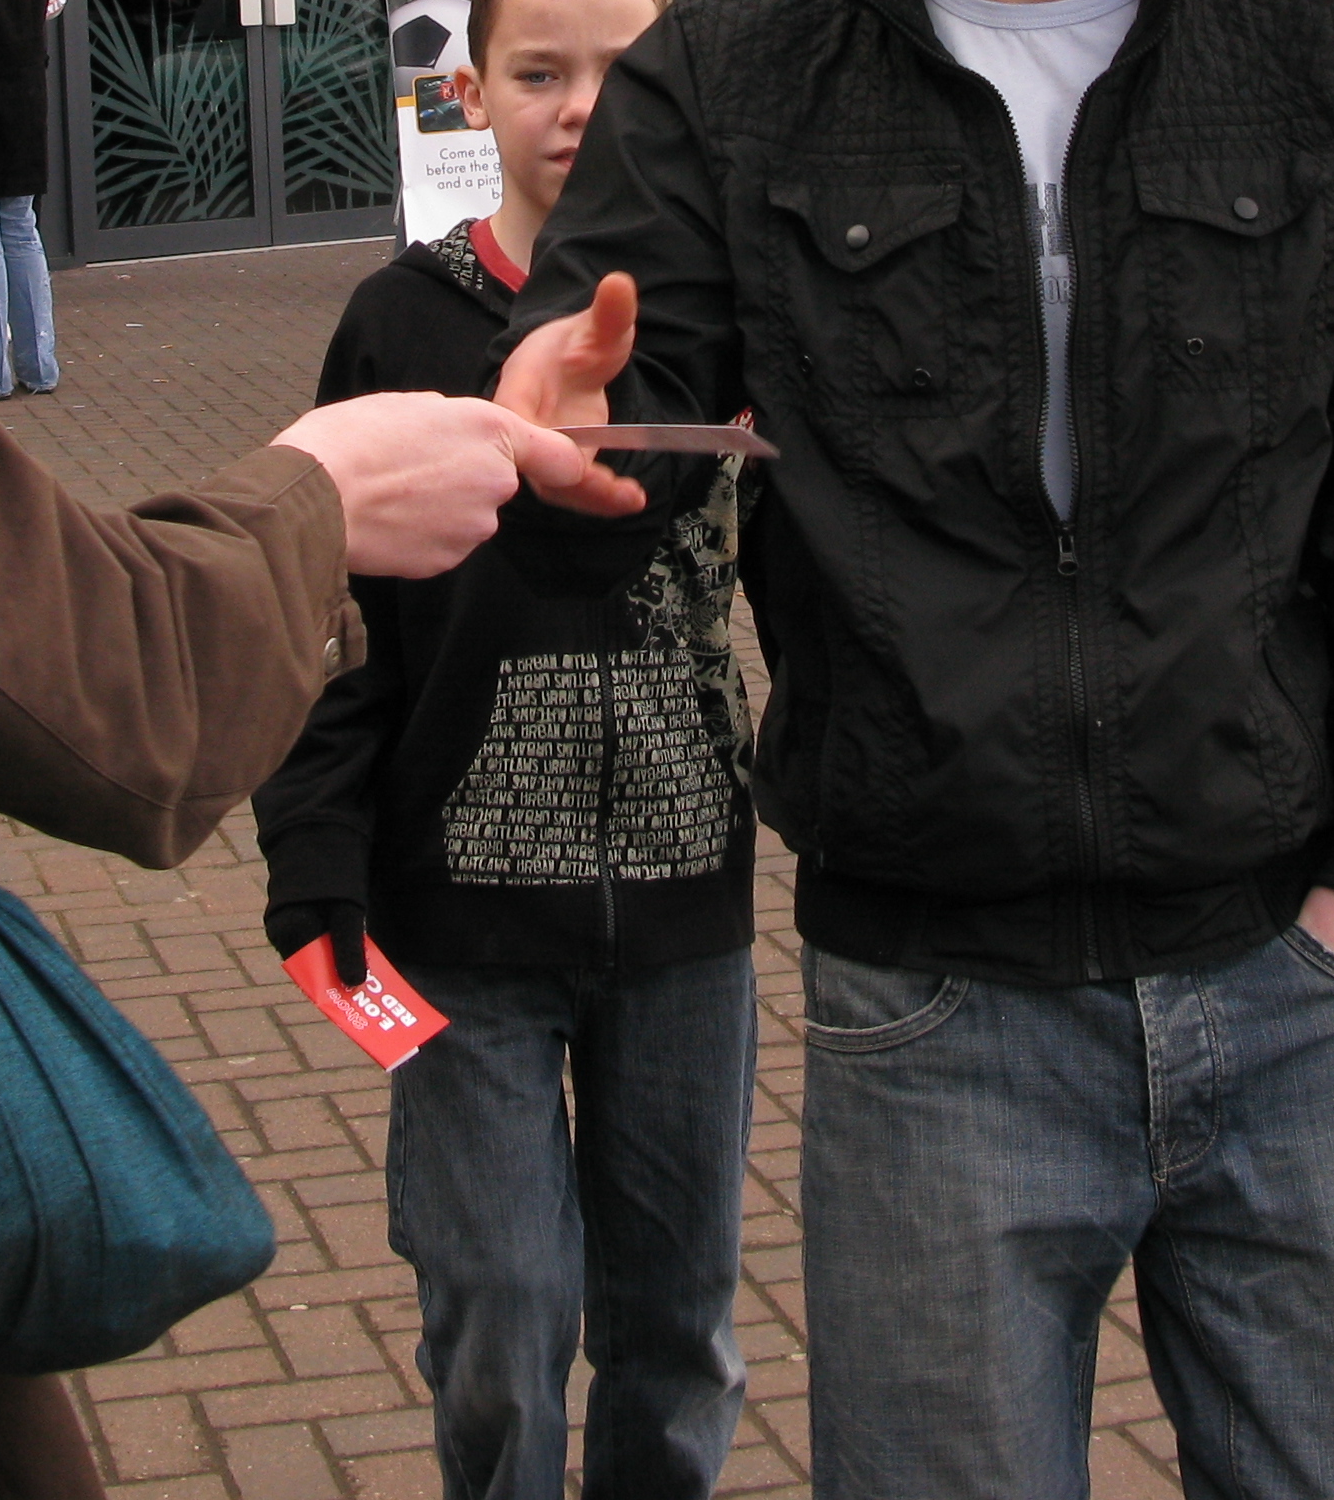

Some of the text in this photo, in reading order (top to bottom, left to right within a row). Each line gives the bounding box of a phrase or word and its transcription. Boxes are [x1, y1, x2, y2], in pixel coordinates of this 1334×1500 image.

[439, 148, 475, 160] Come
[426, 162, 466, 176] before
[470, 160, 489, 172] the
[437, 176, 461, 190] and
[478, 174, 500, 189] pint
[325, 987, 368, 1031] Show
[352, 990, 396, 1031] E.ON
[381, 993, 418, 1027] RED
